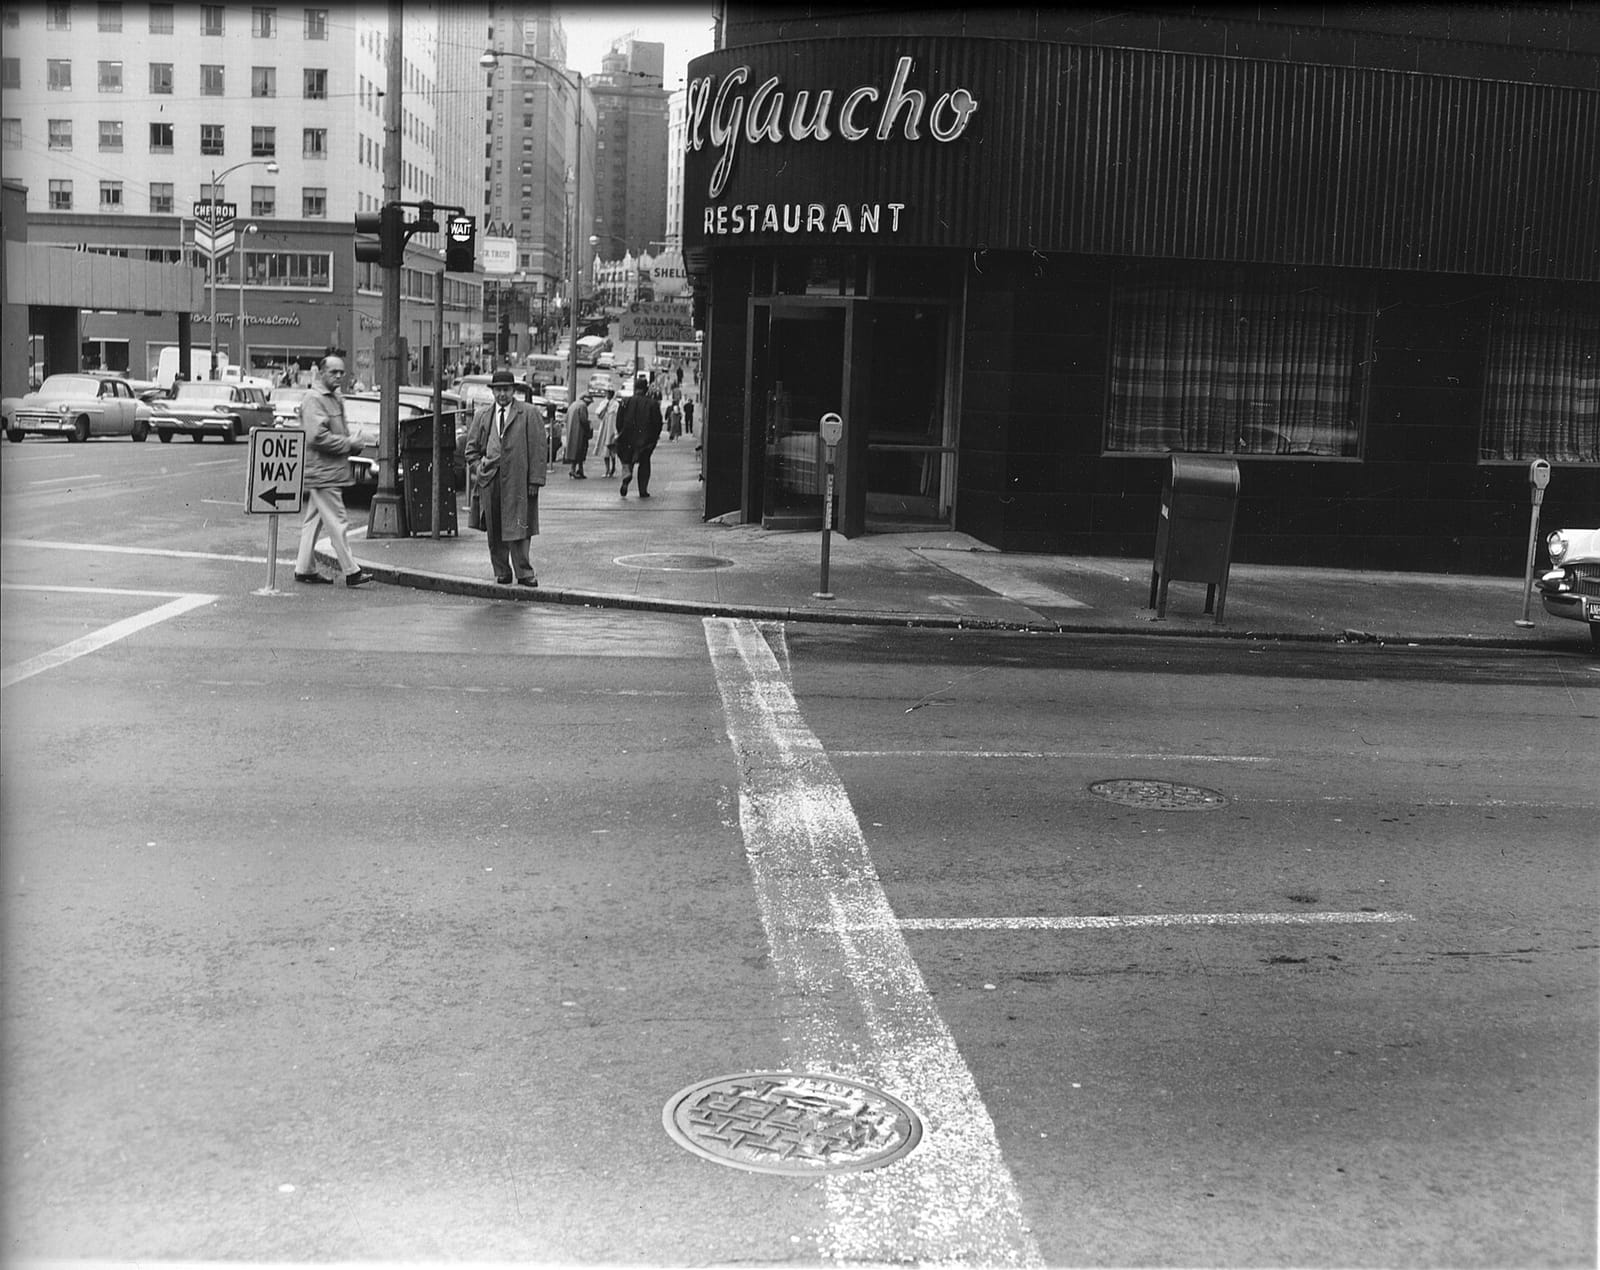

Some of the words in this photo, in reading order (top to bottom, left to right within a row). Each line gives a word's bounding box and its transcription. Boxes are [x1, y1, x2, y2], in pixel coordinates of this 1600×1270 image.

[709, 56, 978, 198] Gaucho
[194, 204, 235, 217] CHERON
[704, 204, 905, 235] RESTAURANT
[450, 223, 472, 235] WAIT
[654, 267, 687, 279] SHELL
[190, 312, 233, 328] orothy
[262, 438, 298, 458] ONE
[260, 462, 298, 481] WAY
